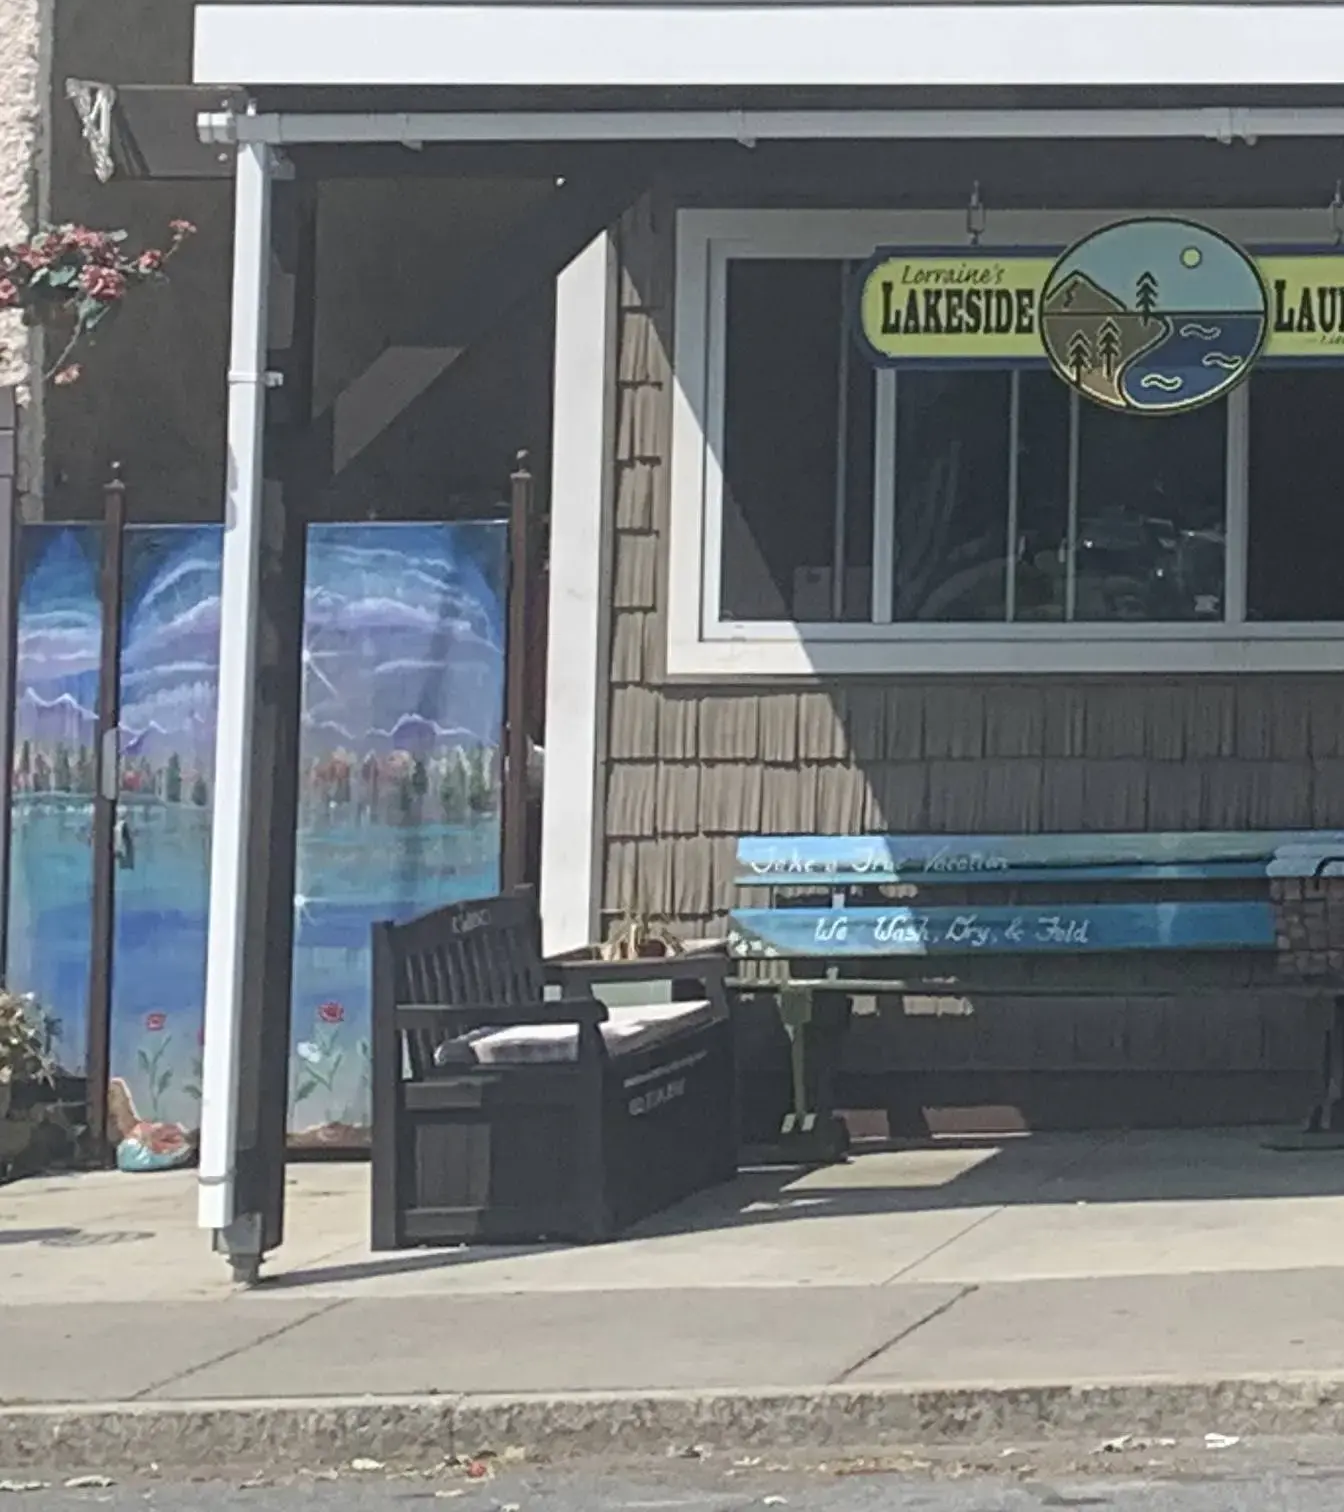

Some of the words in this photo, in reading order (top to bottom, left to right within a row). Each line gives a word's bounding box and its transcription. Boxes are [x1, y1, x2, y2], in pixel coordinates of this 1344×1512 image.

[902, 264, 1005, 285] Lorraine's
[881, 281, 1035, 335] LAKESIDE
[814, 916, 849, 942] We
[1035, 915, 1092, 944] Fold
